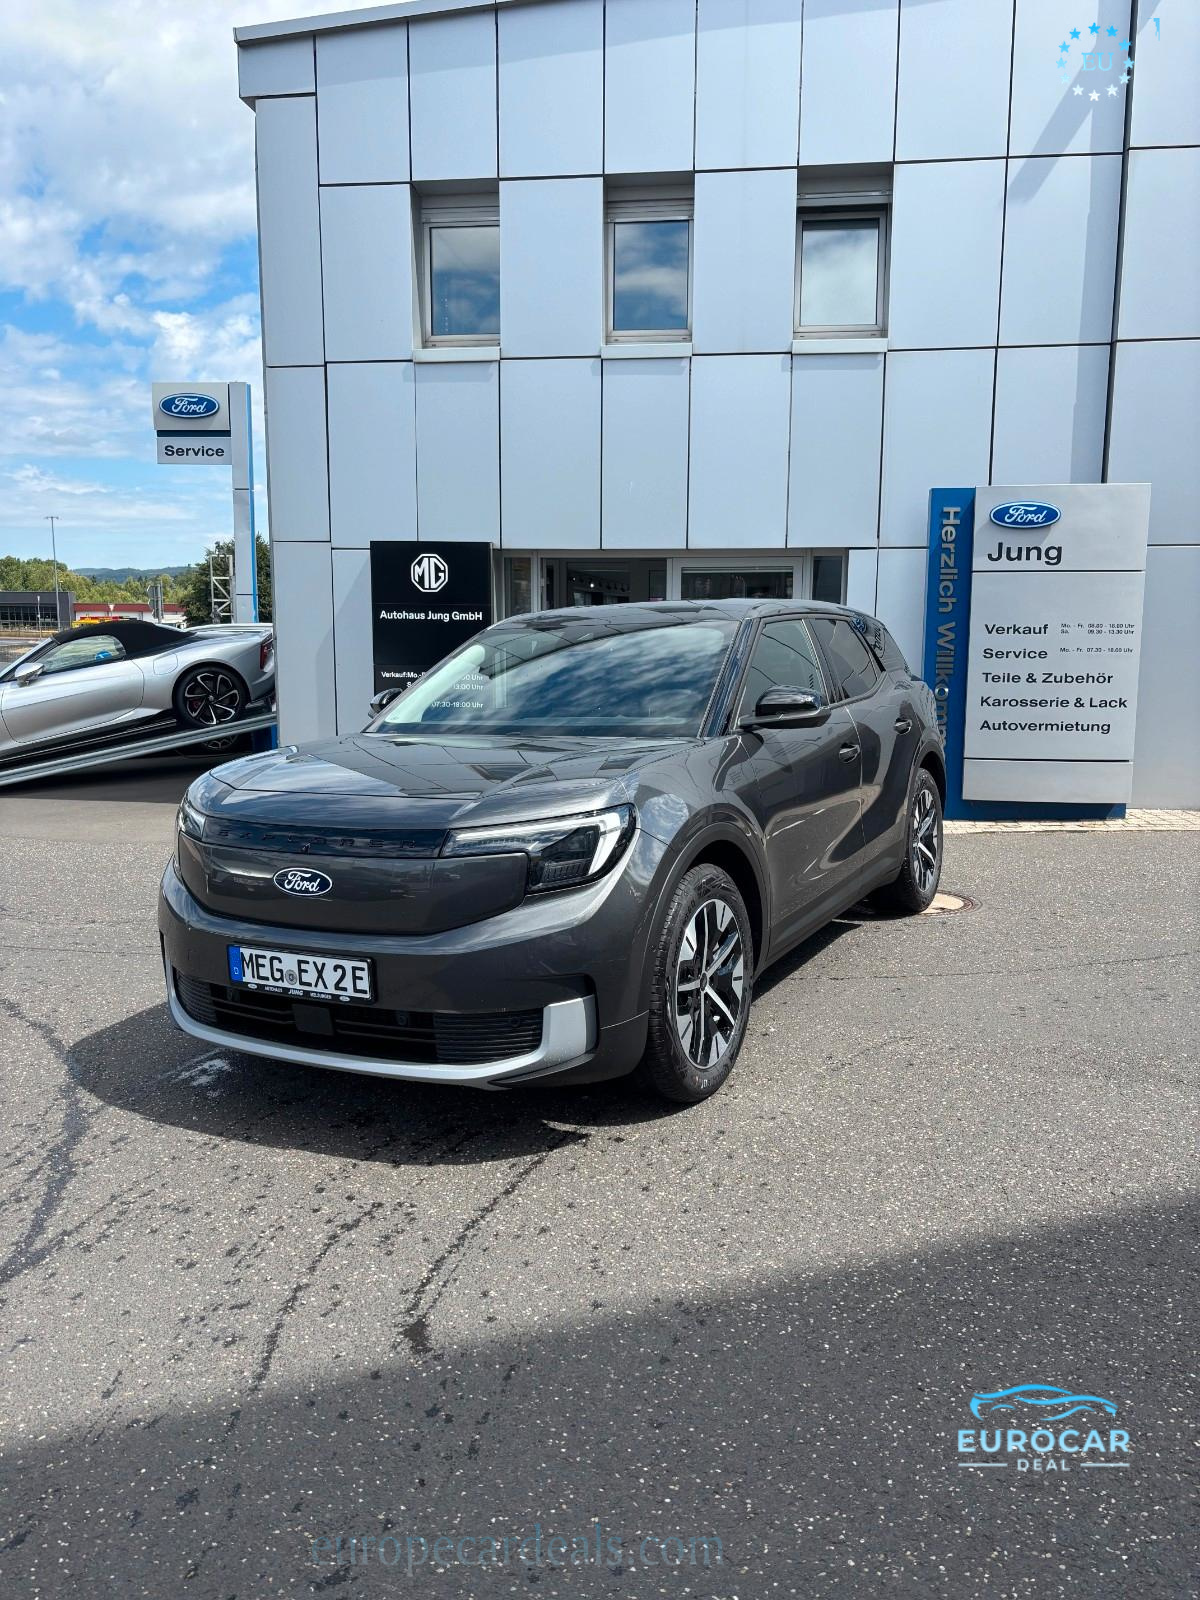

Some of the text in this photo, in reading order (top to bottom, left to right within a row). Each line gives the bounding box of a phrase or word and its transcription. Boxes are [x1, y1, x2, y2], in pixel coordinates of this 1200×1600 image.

[172, 397, 207, 413] Ford
[164, 445, 225, 457] Service
[1004, 505, 1048, 523] Ford
[938, 506, 961, 613] Herzlich
[987, 541, 1063, 566] Jung
[414, 557, 445, 589] MG
[380, 610, 483, 622] Autohaus Jung GmbH
[984, 623, 1049, 635] Verkauf
[983, 647, 1048, 659] Service
[982, 672, 1114, 684] Teile & Zubehör
[980, 695, 1128, 708] Karosserie & Lack
[979, 720, 1111, 735] Autovermietung
[284, 871, 320, 892] Ford
[241, 951, 285, 983] MEG
